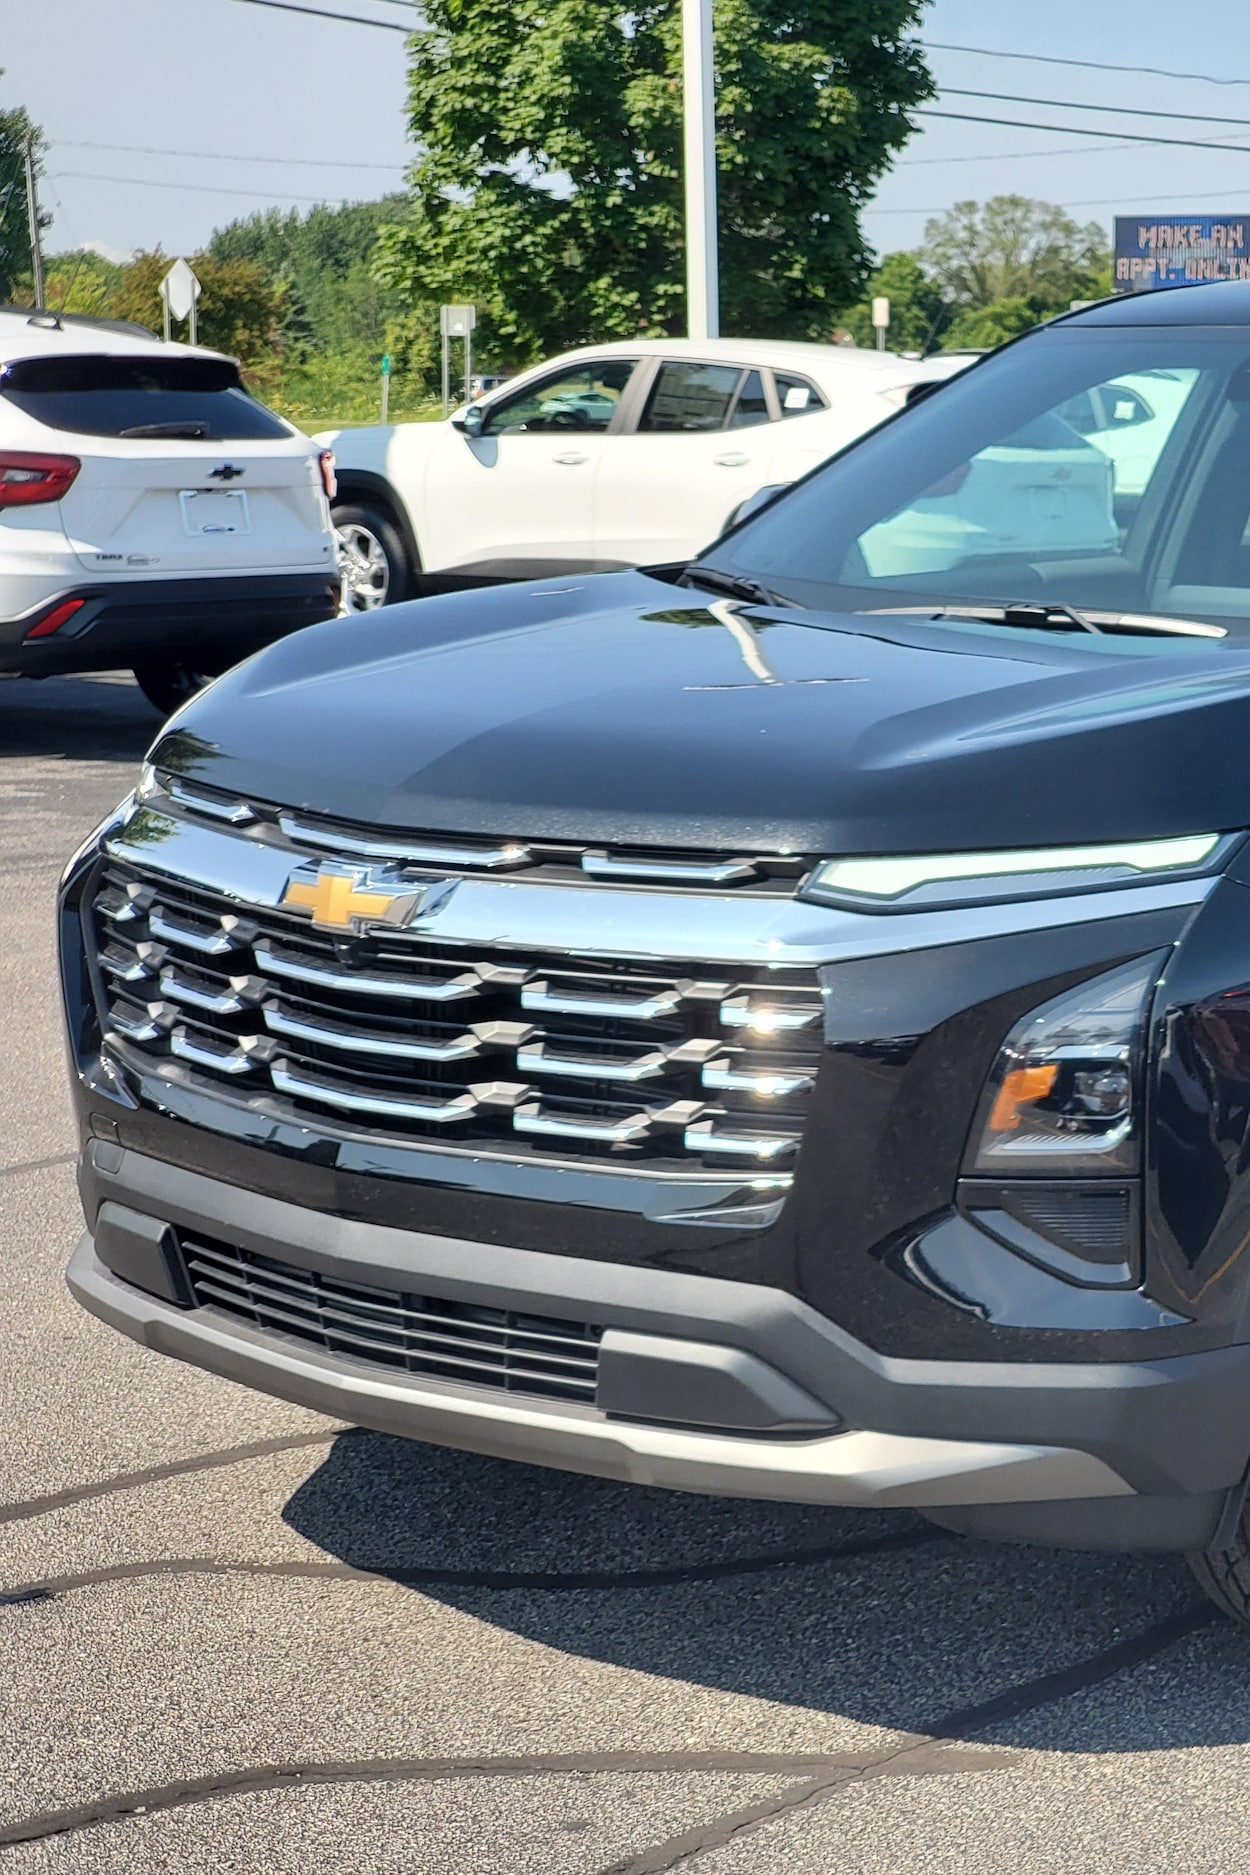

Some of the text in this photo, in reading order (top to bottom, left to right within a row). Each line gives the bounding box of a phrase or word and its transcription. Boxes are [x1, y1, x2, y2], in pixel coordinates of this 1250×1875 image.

[1138, 224, 1244, 248] MAKE AN
[1116, 257, 1176, 280] APPT.
